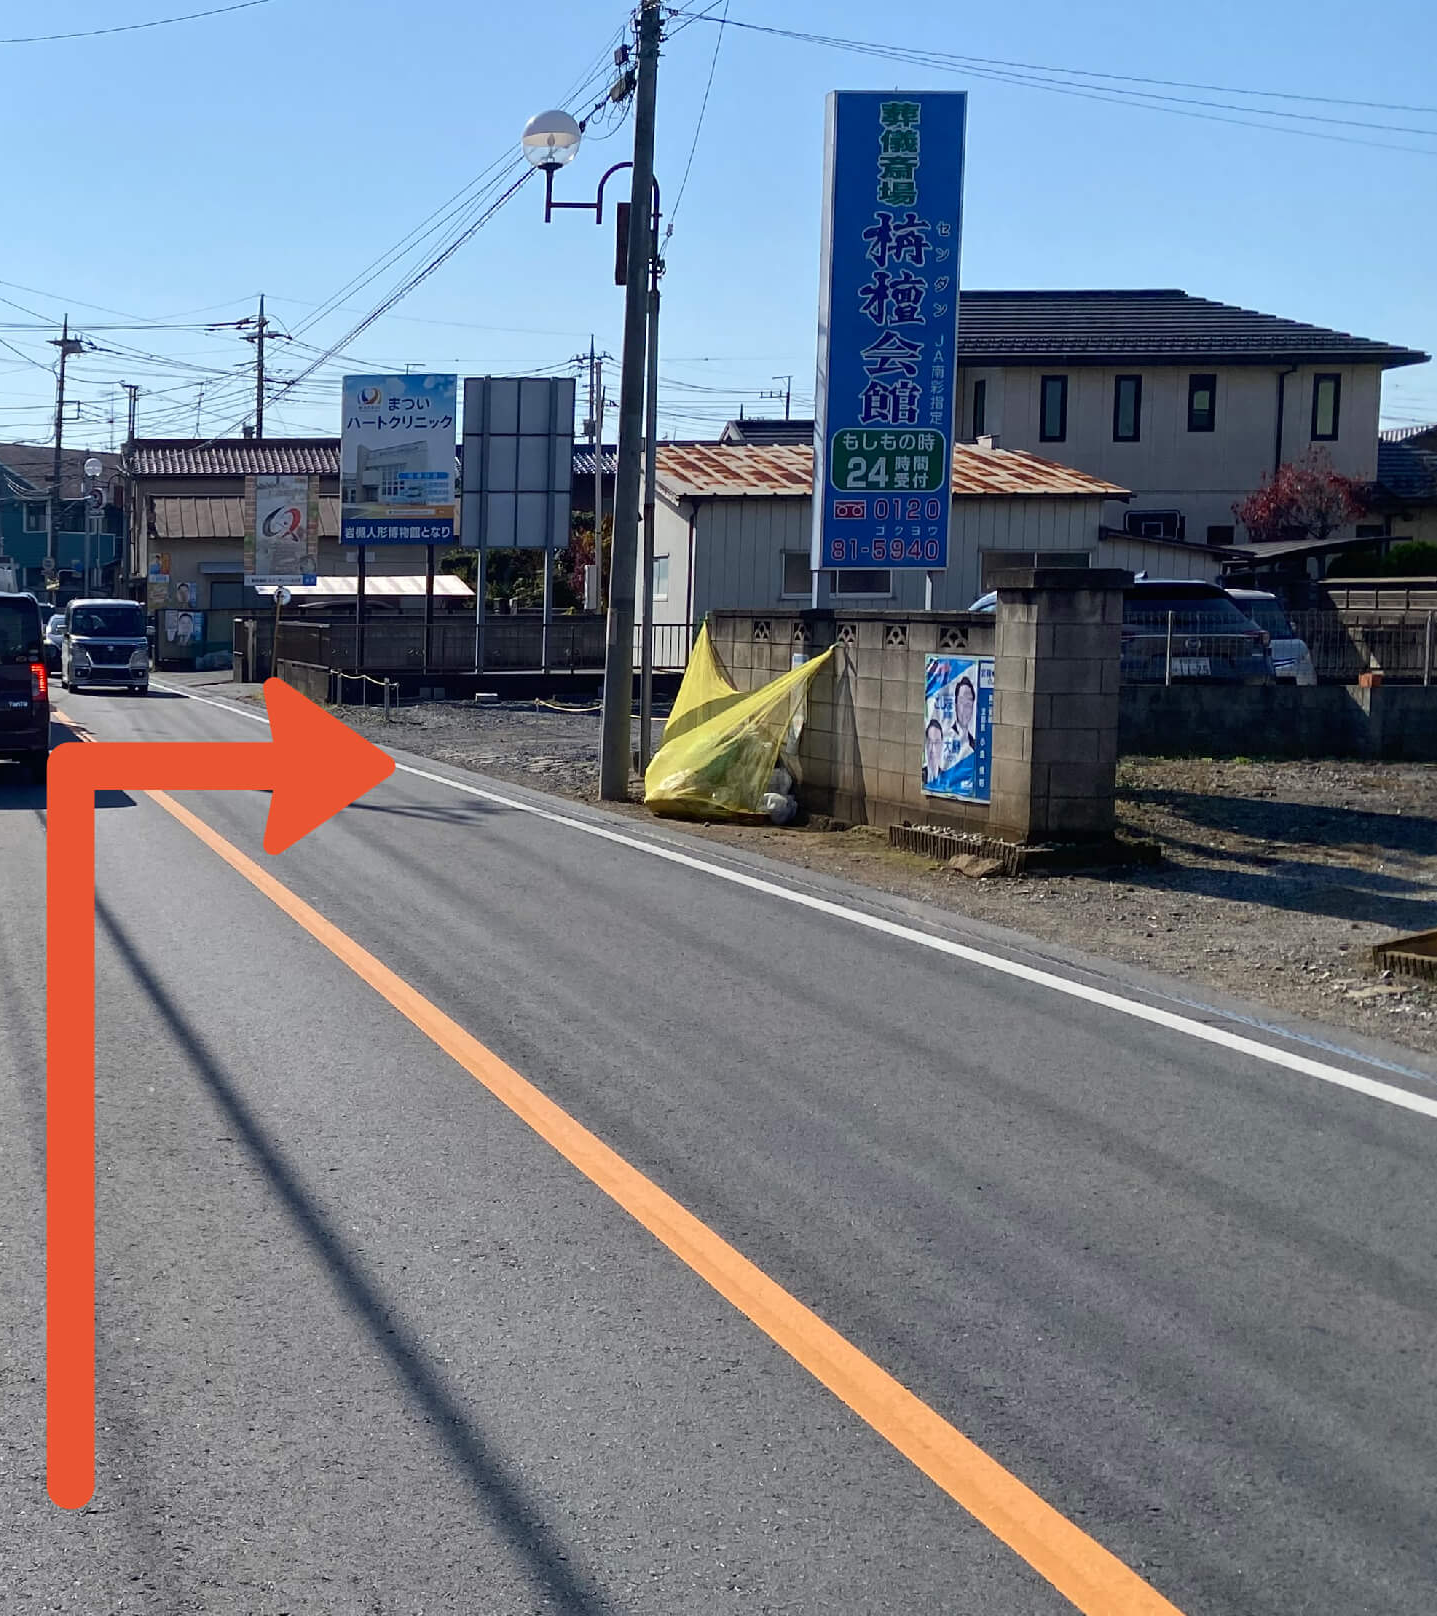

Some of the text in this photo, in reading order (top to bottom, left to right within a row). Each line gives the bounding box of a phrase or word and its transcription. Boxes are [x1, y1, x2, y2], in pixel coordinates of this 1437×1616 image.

[858, 211, 932, 425] 栴檀会館
[388, 397, 430, 411] まつい
[347, 415, 453, 430] ハートクリニック
[842, 433, 936, 451] もしもの時
[846, 456, 929, 488] 24 時間
[893, 472, 929, 488] 受付
[873, 498, 941, 521] 0120
[875, 526, 938, 536] コクヨウ
[830, 538, 940, 561] 81-5940
